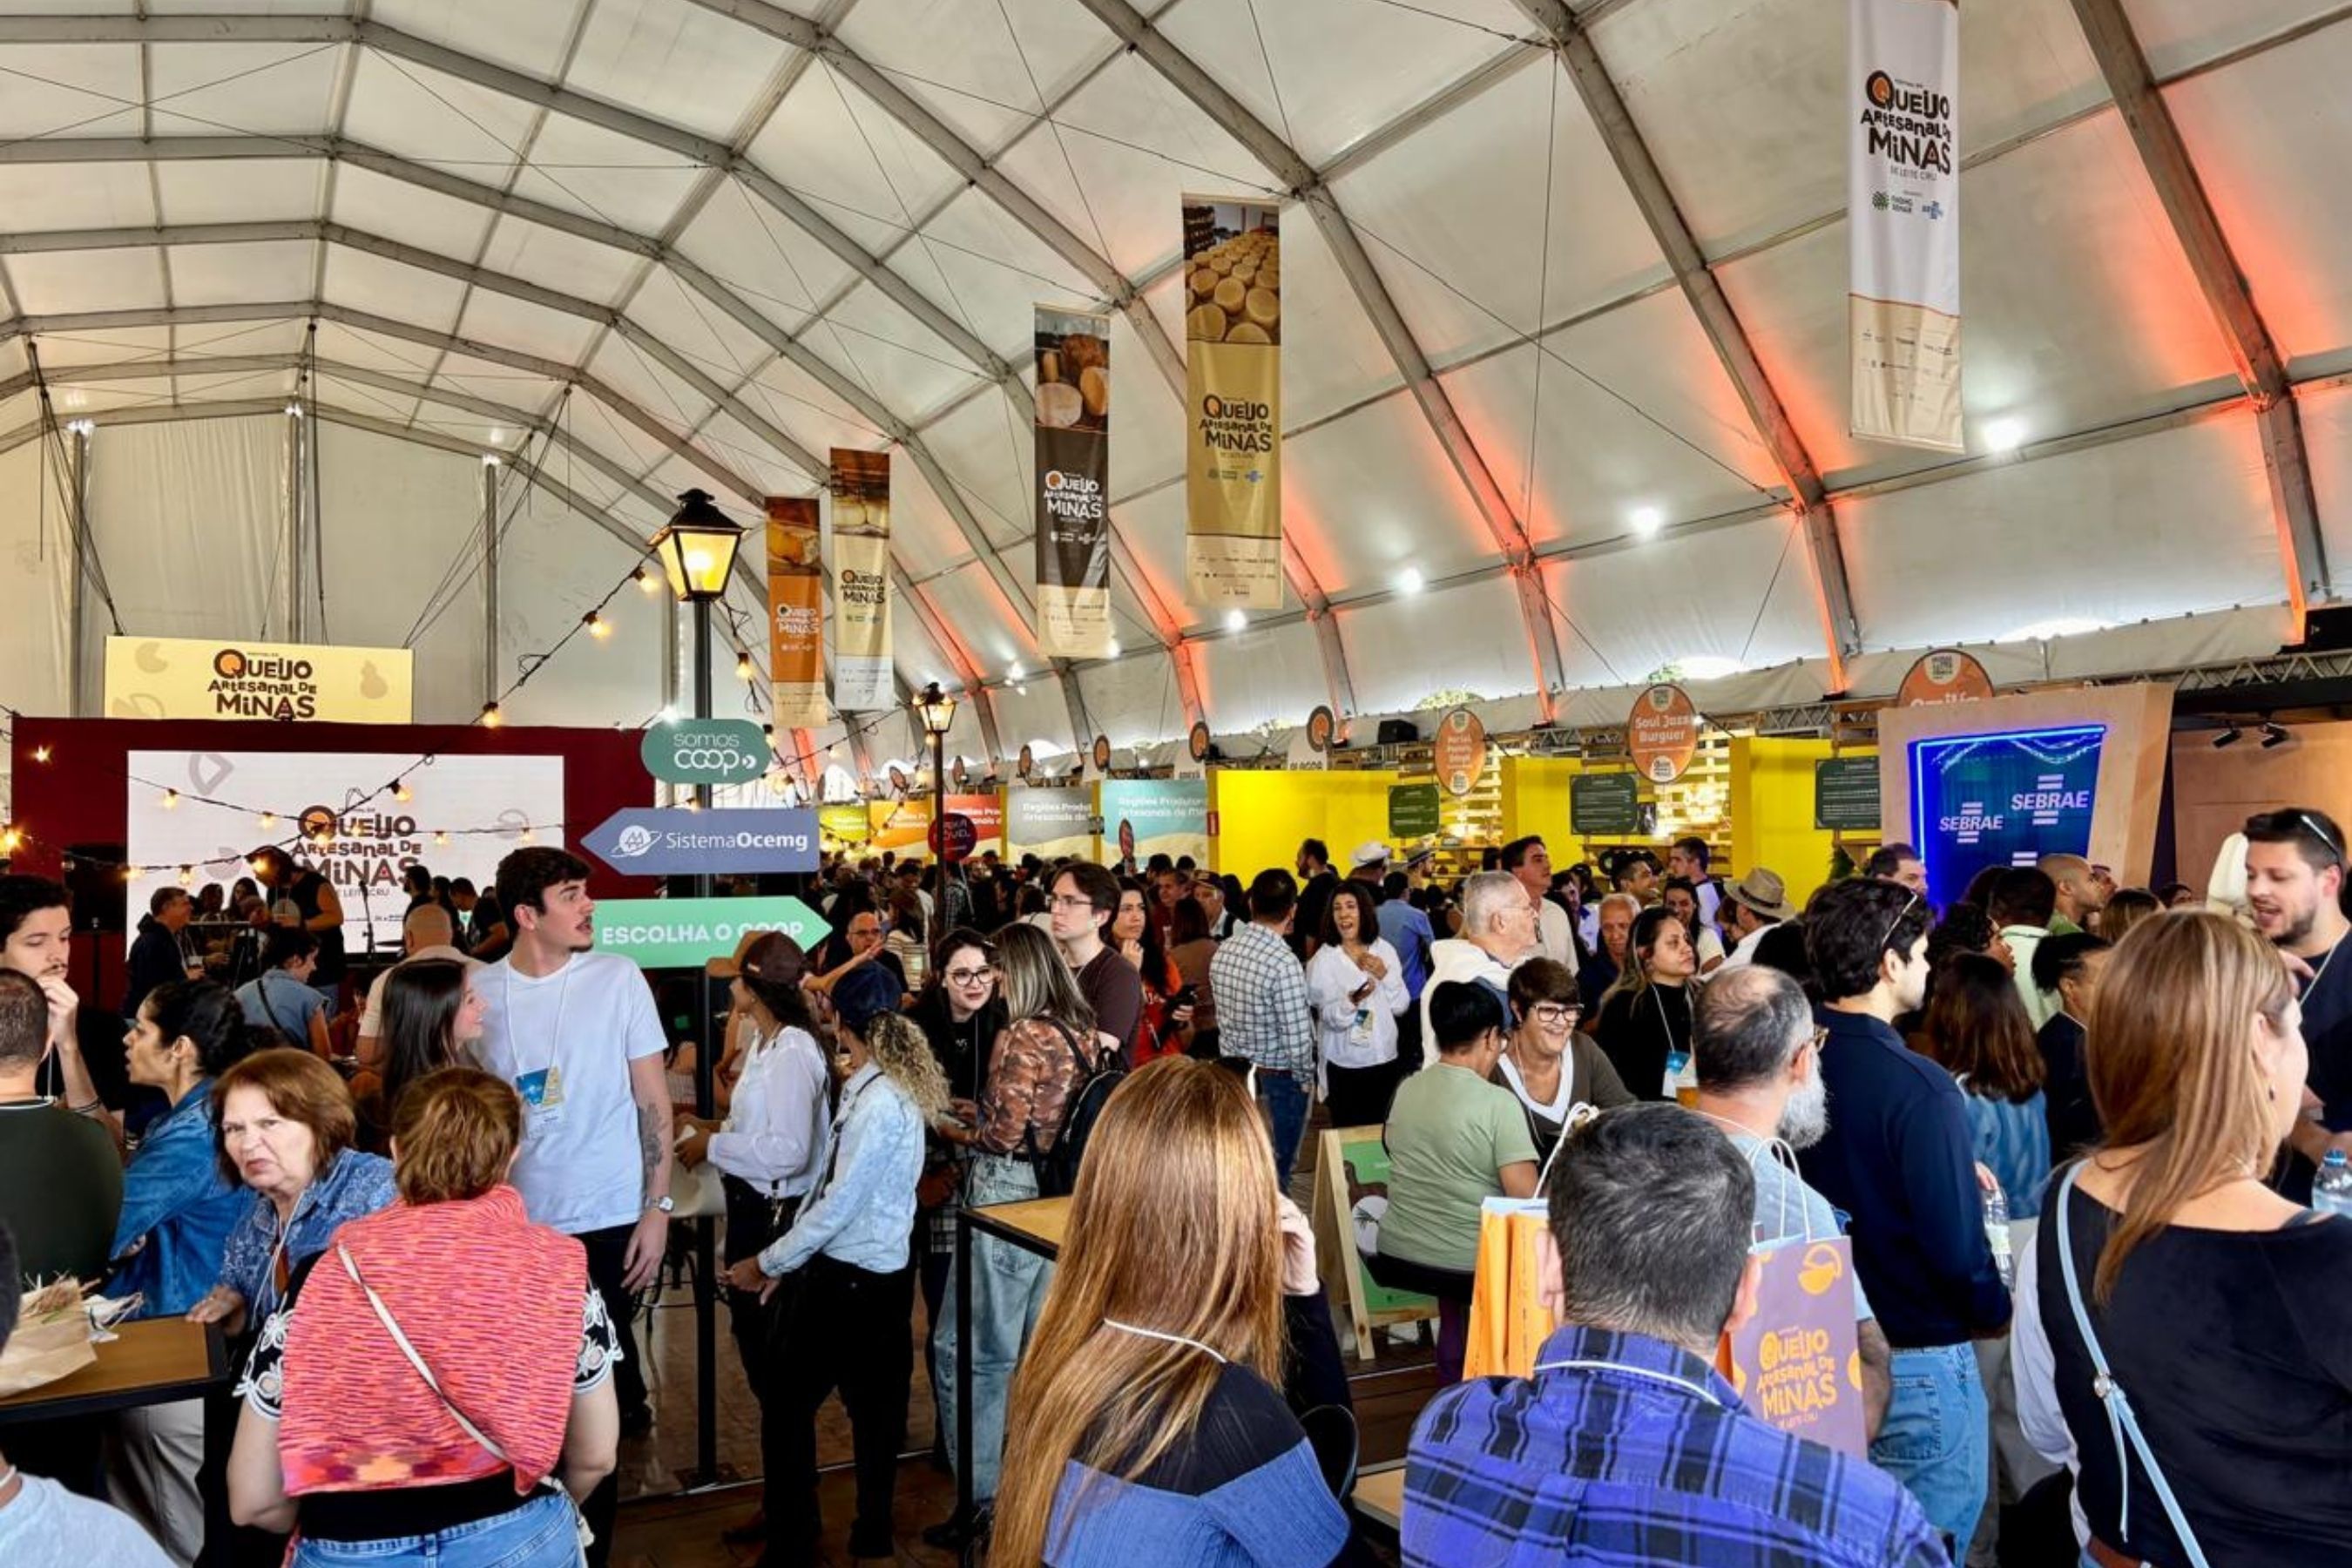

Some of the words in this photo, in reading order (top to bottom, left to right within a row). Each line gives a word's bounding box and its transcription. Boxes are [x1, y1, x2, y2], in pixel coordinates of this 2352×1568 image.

[299, 681, 317, 694] DE
[1635, 715, 1660, 729] Soul
[673, 733, 740, 747] somos
[1639, 730, 1686, 745] Burguer
[2011, 790, 2090, 811] SEBRAE
[1939, 814, 2004, 831] SEBRAE
[400, 840, 422, 855] DE
[666, 832, 808, 852] SistemaOcemg
[343, 888, 364, 897] LEIT
[602, 923, 711, 945] ESCOLHA
[714, 923, 733, 942] O
